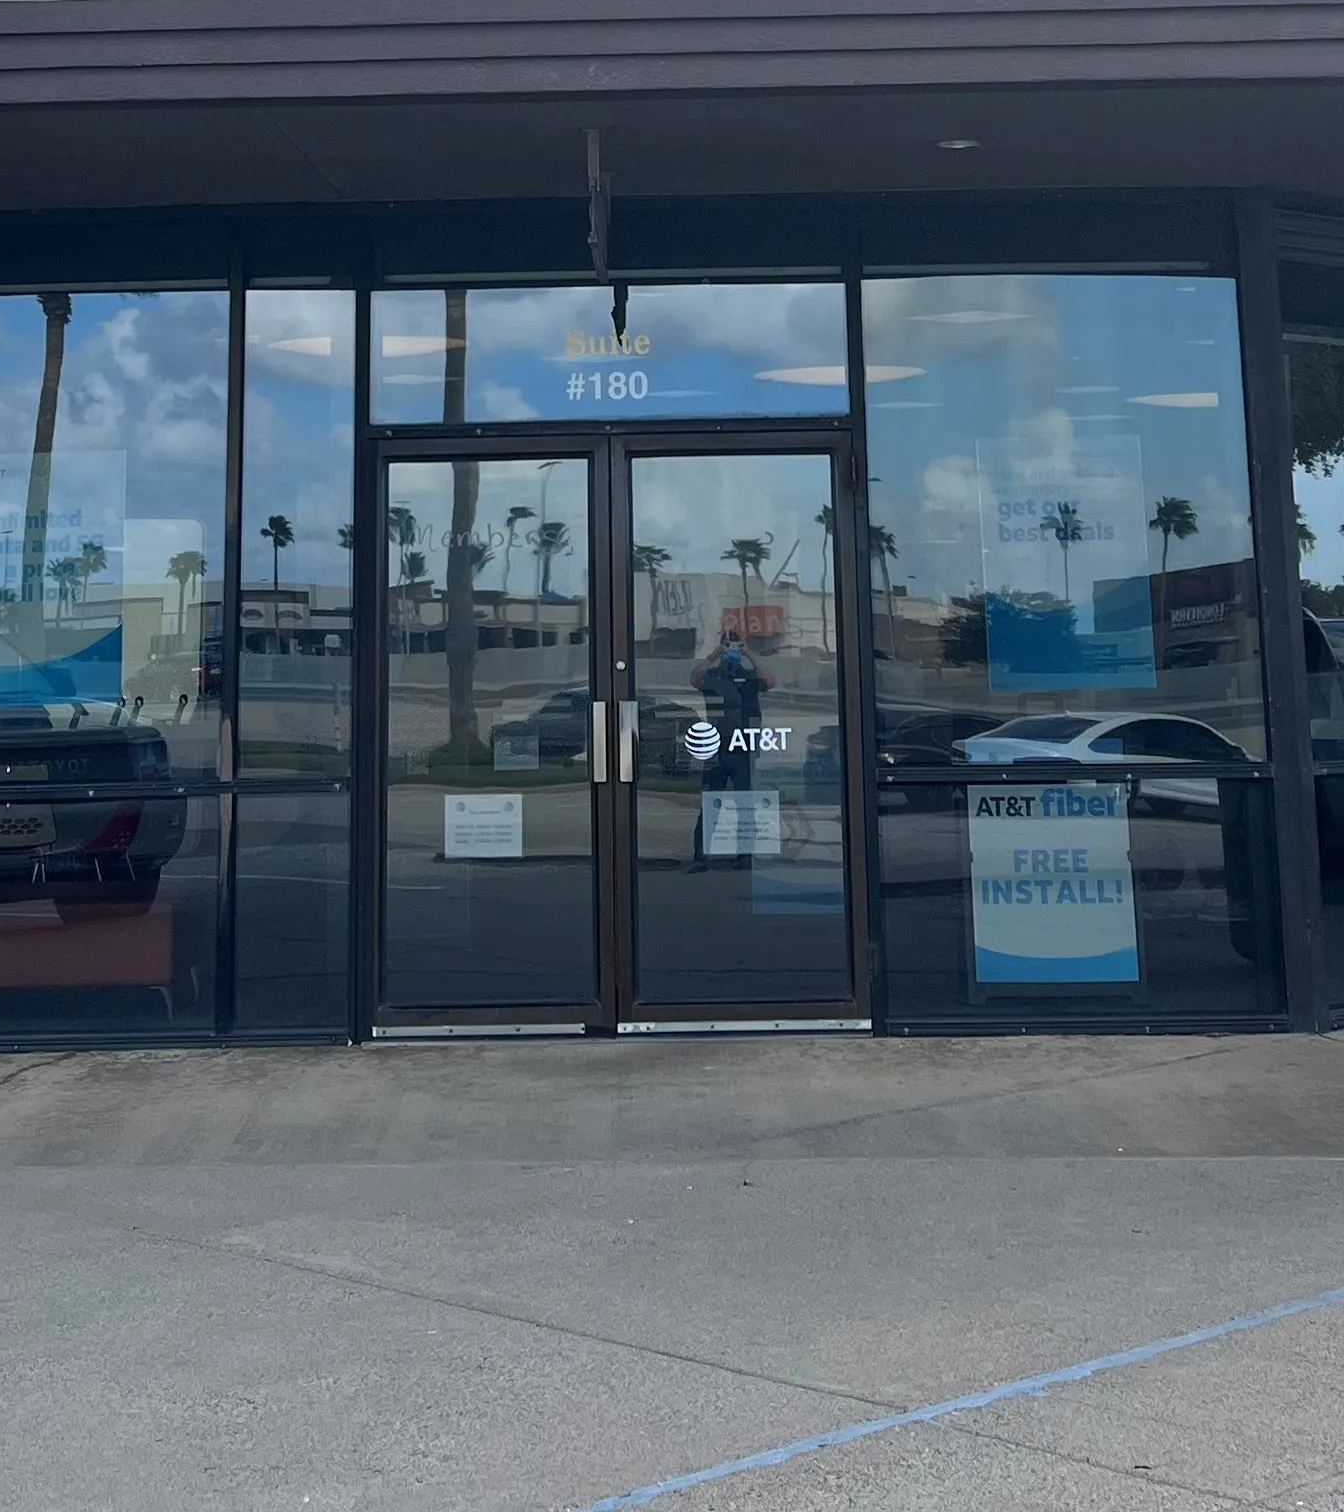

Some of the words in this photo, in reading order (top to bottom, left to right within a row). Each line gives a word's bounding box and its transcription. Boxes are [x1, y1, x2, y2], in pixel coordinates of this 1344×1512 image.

[565, 328, 651, 356] Suite
[566, 370, 648, 400] #180
[997, 499, 1037, 522] get
[32, 533, 71, 553] and
[998, 522, 1049, 542] best
[1055, 521, 1115, 541] deals
[23, 562, 75, 585] prce
[728, 727, 792, 752] AT&T
[975, 796, 1036, 817] AT&T
[1040, 787, 1119, 817] fiber
[1013, 848, 1089, 874] FREE
[981, 879, 1124, 905] INSTALL!
